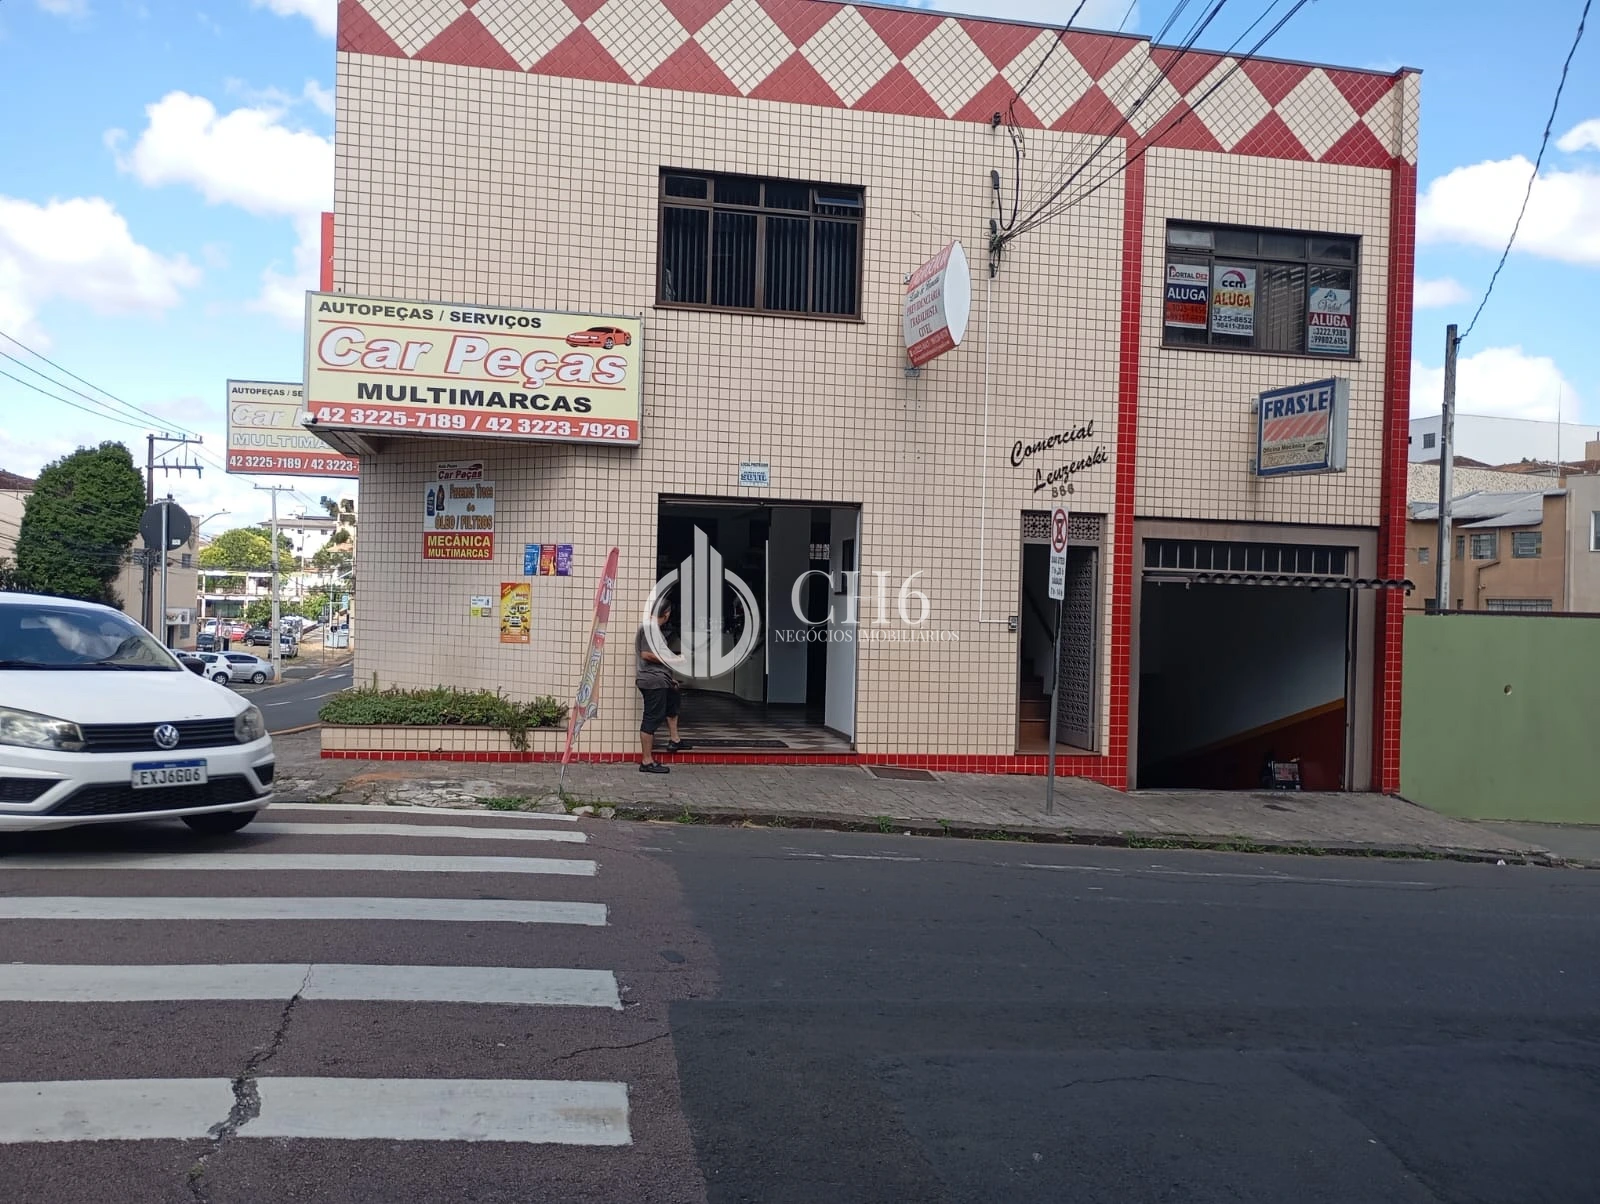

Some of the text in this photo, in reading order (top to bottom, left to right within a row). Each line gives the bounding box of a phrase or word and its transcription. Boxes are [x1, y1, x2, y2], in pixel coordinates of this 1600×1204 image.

[1221, 279, 1246, 289] ccm
[1167, 287, 1206, 302] ALUGA
[1214, 293, 1251, 308] ALUGA
[318, 300, 434, 322] AUTOPEÇAS
[449, 310, 542, 329] SERVIÇOS
[1311, 313, 1348, 327] ALUGA
[317, 327, 629, 390] Car Peças
[231, 387, 285, 397] AUTOPEÇAS
[357, 382, 593, 414] MULTIMARCAS
[231, 403, 285, 427] Car
[315, 406, 345, 423] 42
[350, 409, 466, 430] 3225-7189
[485, 416, 513, 433] 42
[518, 418, 631, 441] 3223-7926
[1010, 419, 1095, 467] Comercial
[229, 455, 243, 467] 42
[246, 456, 301, 469] 3225-7189
[311, 459, 324, 470] 42
[438, 470, 454, 480] Car
[427, 533, 491, 547] MECÂNICA
[428, 548, 490, 558] MULTIMARCAS
